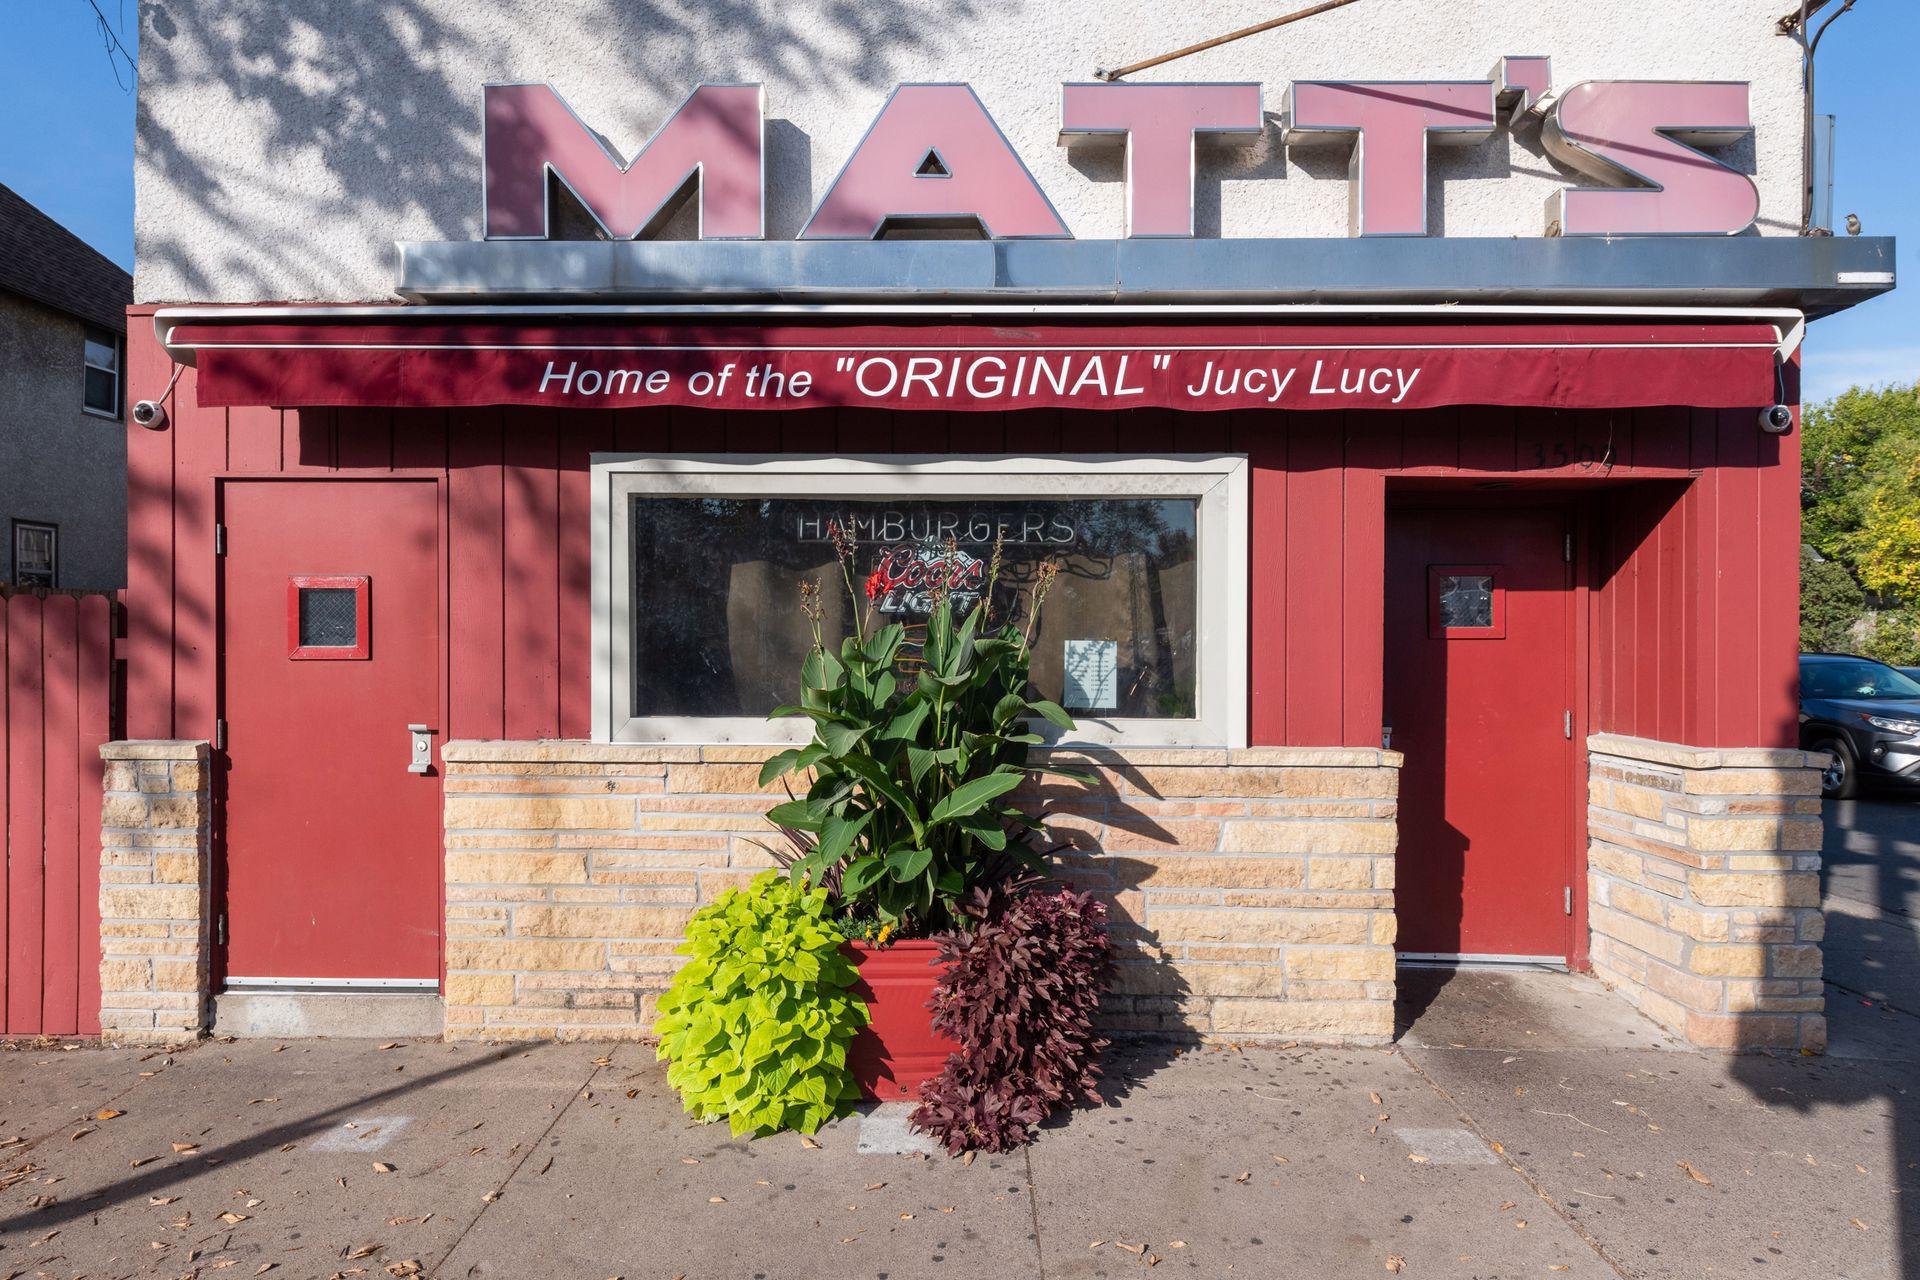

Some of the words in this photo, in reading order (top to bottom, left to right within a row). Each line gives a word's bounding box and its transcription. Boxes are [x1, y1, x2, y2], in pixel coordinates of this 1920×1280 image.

[482, 56, 1760, 239] MATT'S
[538, 361, 670, 396] Home
[687, 363, 737, 397] of
[745, 363, 813, 398] the
[836, 354, 1172, 399] "ORIGINAL"
[1187, 361, 1297, 403] Jucy
[1309, 359, 1421, 404] Lucy
[798, 511, 1075, 543] HAMBURGERS
[878, 543, 988, 590] Coors
[879, 590, 980, 614] LIGT
